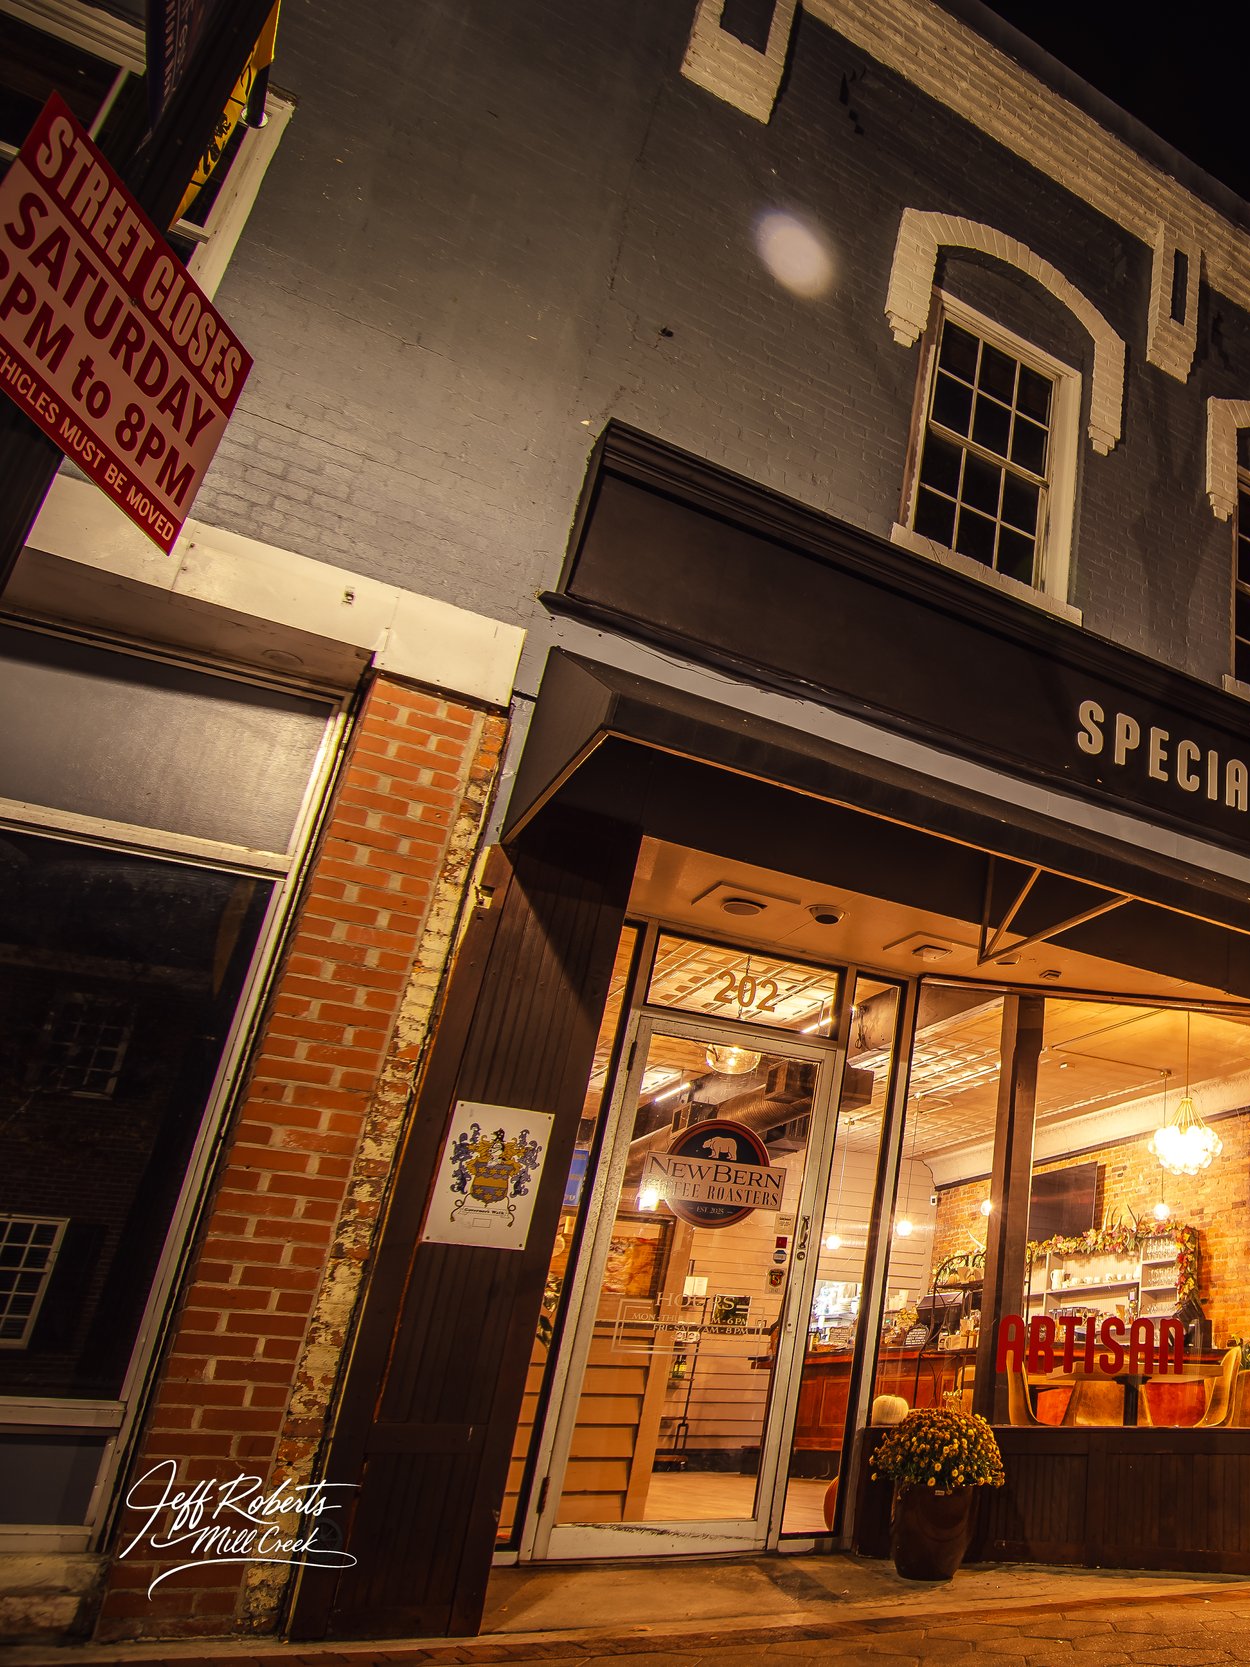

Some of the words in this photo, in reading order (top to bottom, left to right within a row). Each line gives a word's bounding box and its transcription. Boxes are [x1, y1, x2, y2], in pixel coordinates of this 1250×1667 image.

[36, 116, 155, 281] STREET
[143, 255, 242, 399] CLOSES
[4, 192, 215, 447] SATURDAY
[72, 355, 111, 419] to
[115, 403, 195, 507] 8PM
[59, 417, 105, 468] MUST
[104, 463, 127, 494] BE
[126, 486, 174, 541] MOVED
[713, 971, 779, 1013] 202
[707, 1185, 779, 1206] ROASTERS
[655, 1292, 735, 1310] HOURS
[996, 1314, 1185, 1375] ARTISAN
